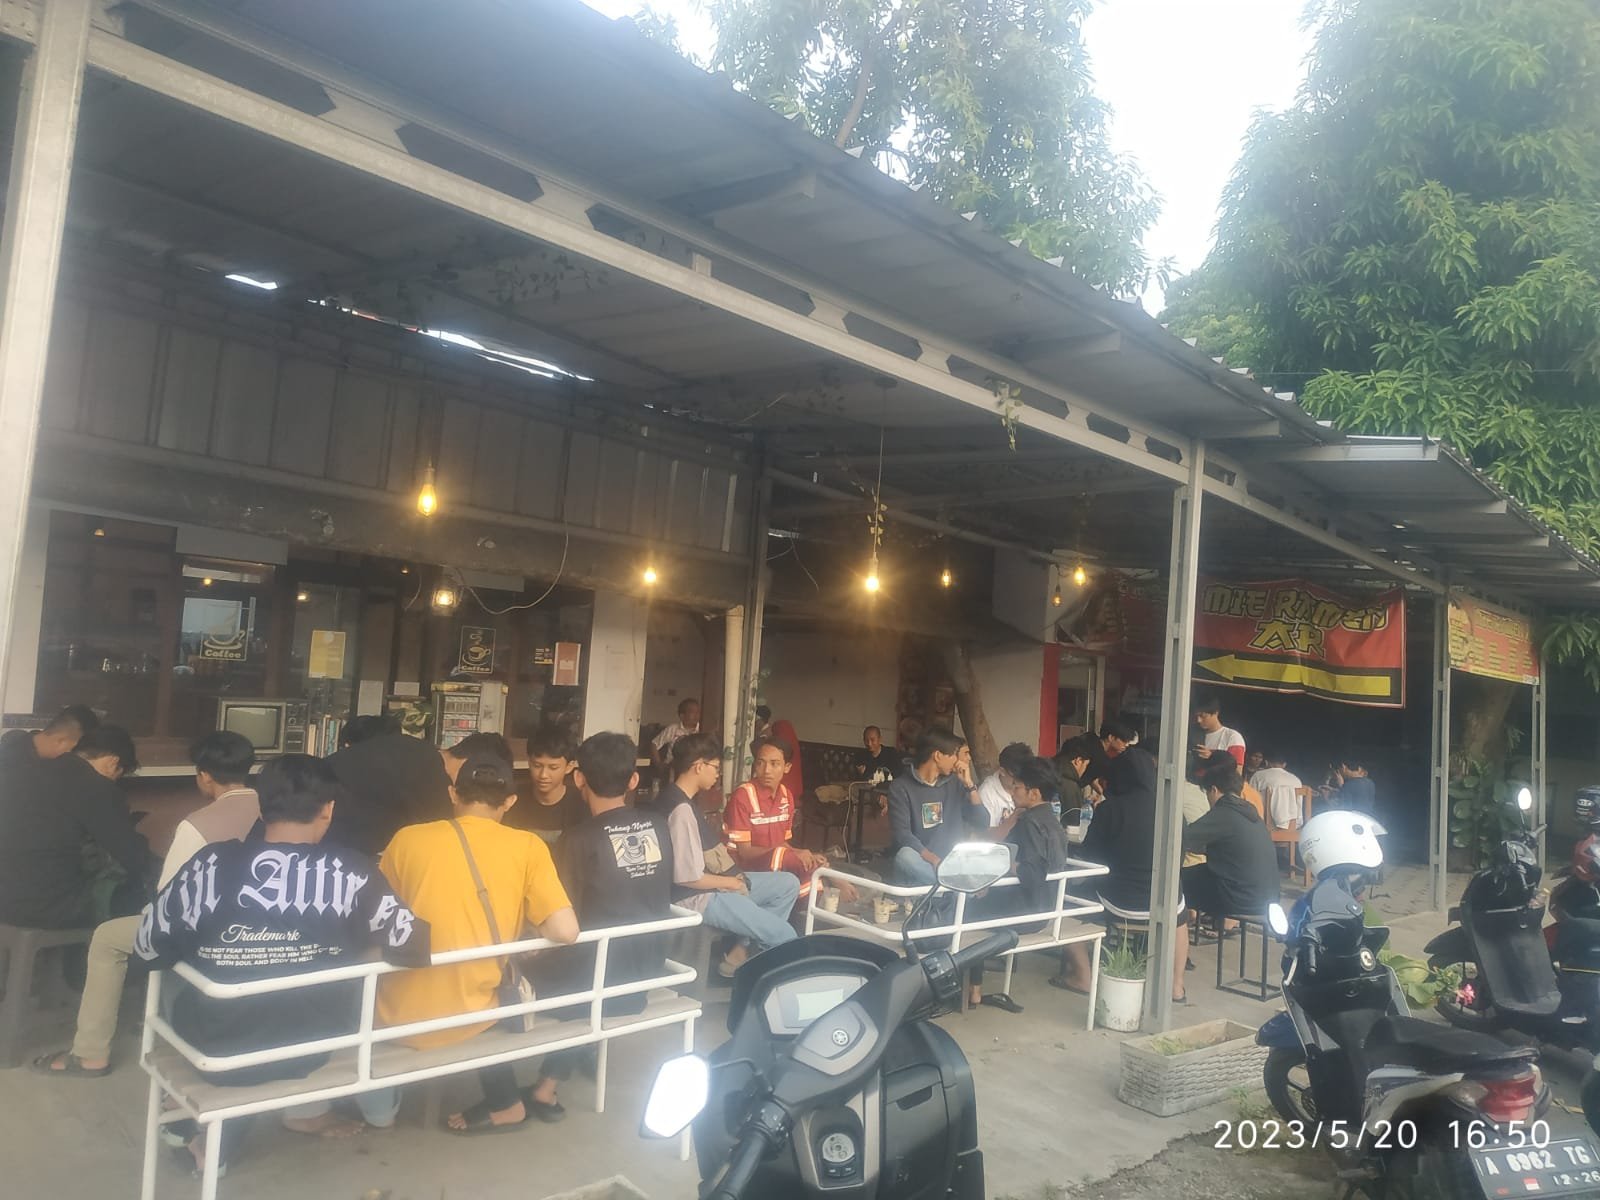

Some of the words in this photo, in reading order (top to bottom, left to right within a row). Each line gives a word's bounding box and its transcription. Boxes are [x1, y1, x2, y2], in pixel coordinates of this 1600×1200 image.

[1202, 585, 1268, 618] MIE
[1272, 588, 1389, 631] RAMEN
[204, 649, 242, 659] Coffee
[221, 924, 301, 943] Trademark
[1485, 1156, 1500, 1175] A
